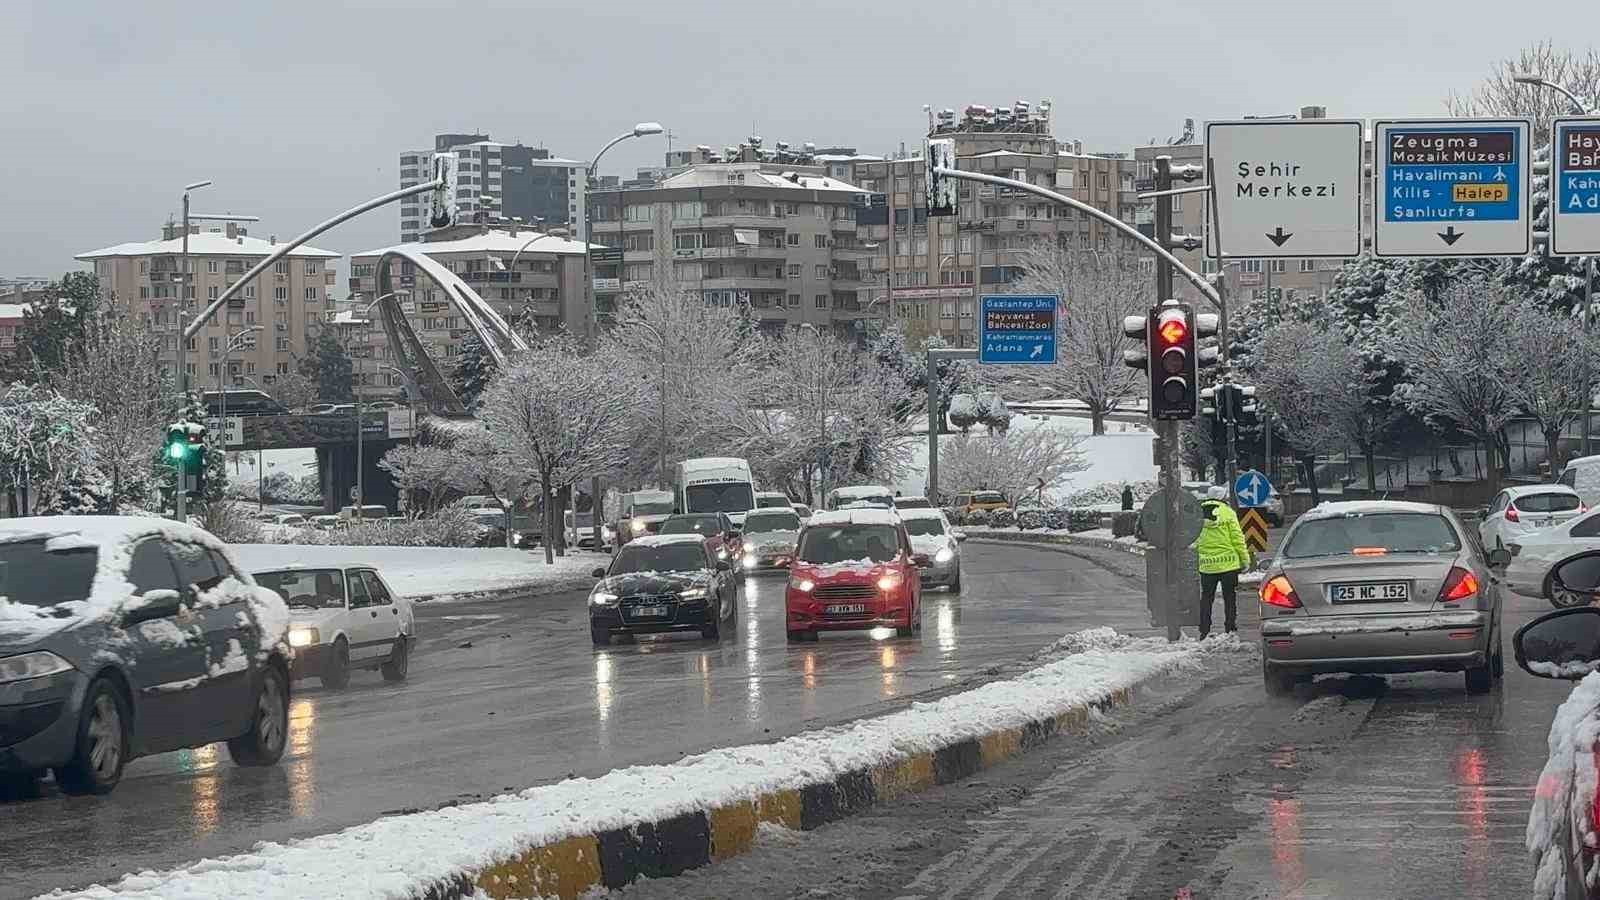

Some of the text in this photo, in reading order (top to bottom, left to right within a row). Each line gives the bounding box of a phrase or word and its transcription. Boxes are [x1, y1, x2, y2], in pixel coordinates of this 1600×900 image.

[1393, 135, 1478, 151] Zeugma
[1393, 151, 1449, 162] Mozaik
[1238, 162, 1301, 179] Şehir
[1237, 182, 1335, 198] Merkezi
[1568, 177, 1600, 190] Kah
[1456, 187, 1503, 201] Halep
[986, 343, 1023, 352] Adana
[1339, 585, 1405, 600] 25 NC 152
